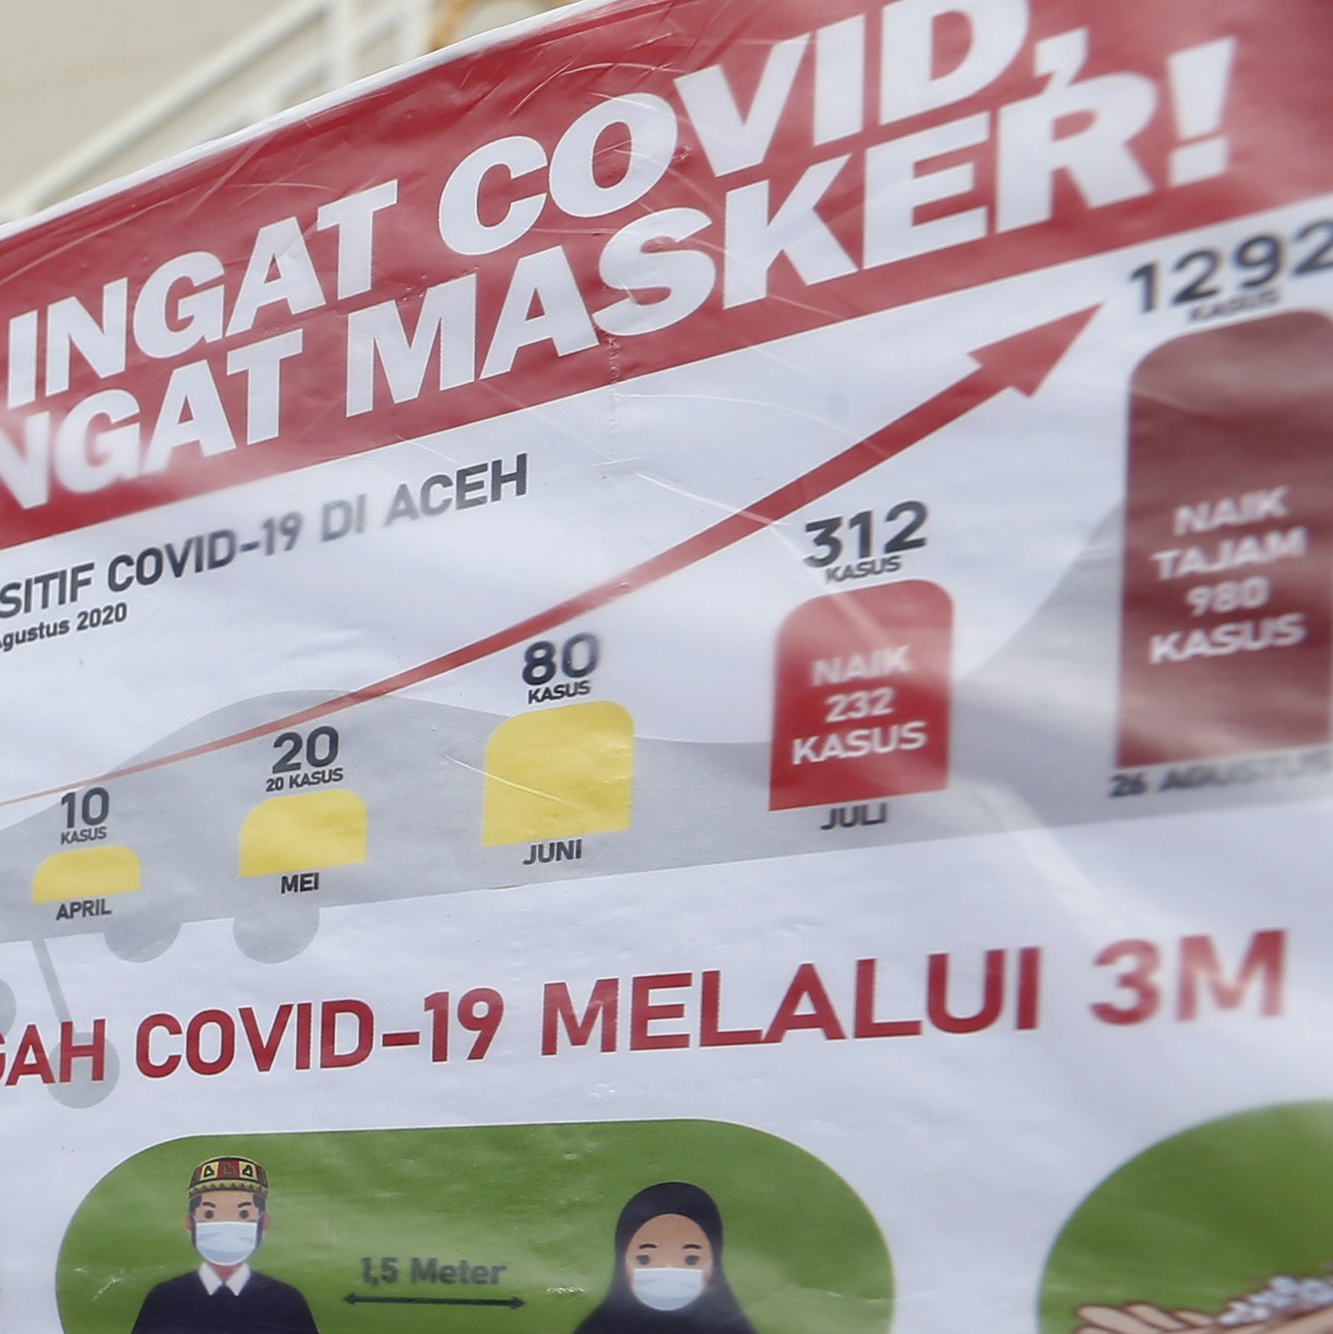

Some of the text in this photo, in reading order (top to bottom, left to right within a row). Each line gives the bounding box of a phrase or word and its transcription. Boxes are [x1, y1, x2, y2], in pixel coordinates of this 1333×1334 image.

[6, 0, 1089, 408] INGAT COVID,
[345, 37, 1235, 417] MASKER!
[1128, 218, 1333, 315] 1292
[107, 512, 302, 592] COVID-19
[321, 494, 367, 543] DI
[384, 453, 528, 527] ACEH
[1175, 485, 1289, 537] NAIK
[803, 500, 928, 570] 312
[1151, 527, 1308, 582] TAJAM
[824, 556, 902, 585] KASUS
[77, 603, 127, 633] 2020
[1148, 614, 1306, 665] KASUS
[521, 632, 600, 687] 80
[811, 643, 912, 687] NAIK
[527, 681, 591, 704] KASUS
[826, 688, 894, 723] 232
[272, 725, 340, 775] 20
[792, 722, 927, 764] KASUS
[266, 768, 344, 792] 20 KASUS
[60, 787, 110, 830] 10
[820, 803, 888, 831] JULI
[61, 826, 107, 845] KASUS
[522, 839, 582, 867] JUNI
[280, 873, 320, 895] MEI
[56, 898, 112, 921] APRIL
[135, 988, 505, 1080] COVID-19
[541, 946, 1043, 1058] MELALUI
[1088, 928, 1289, 1028] 3M
[360, 1254, 507, 1290] 1,5 Meter
